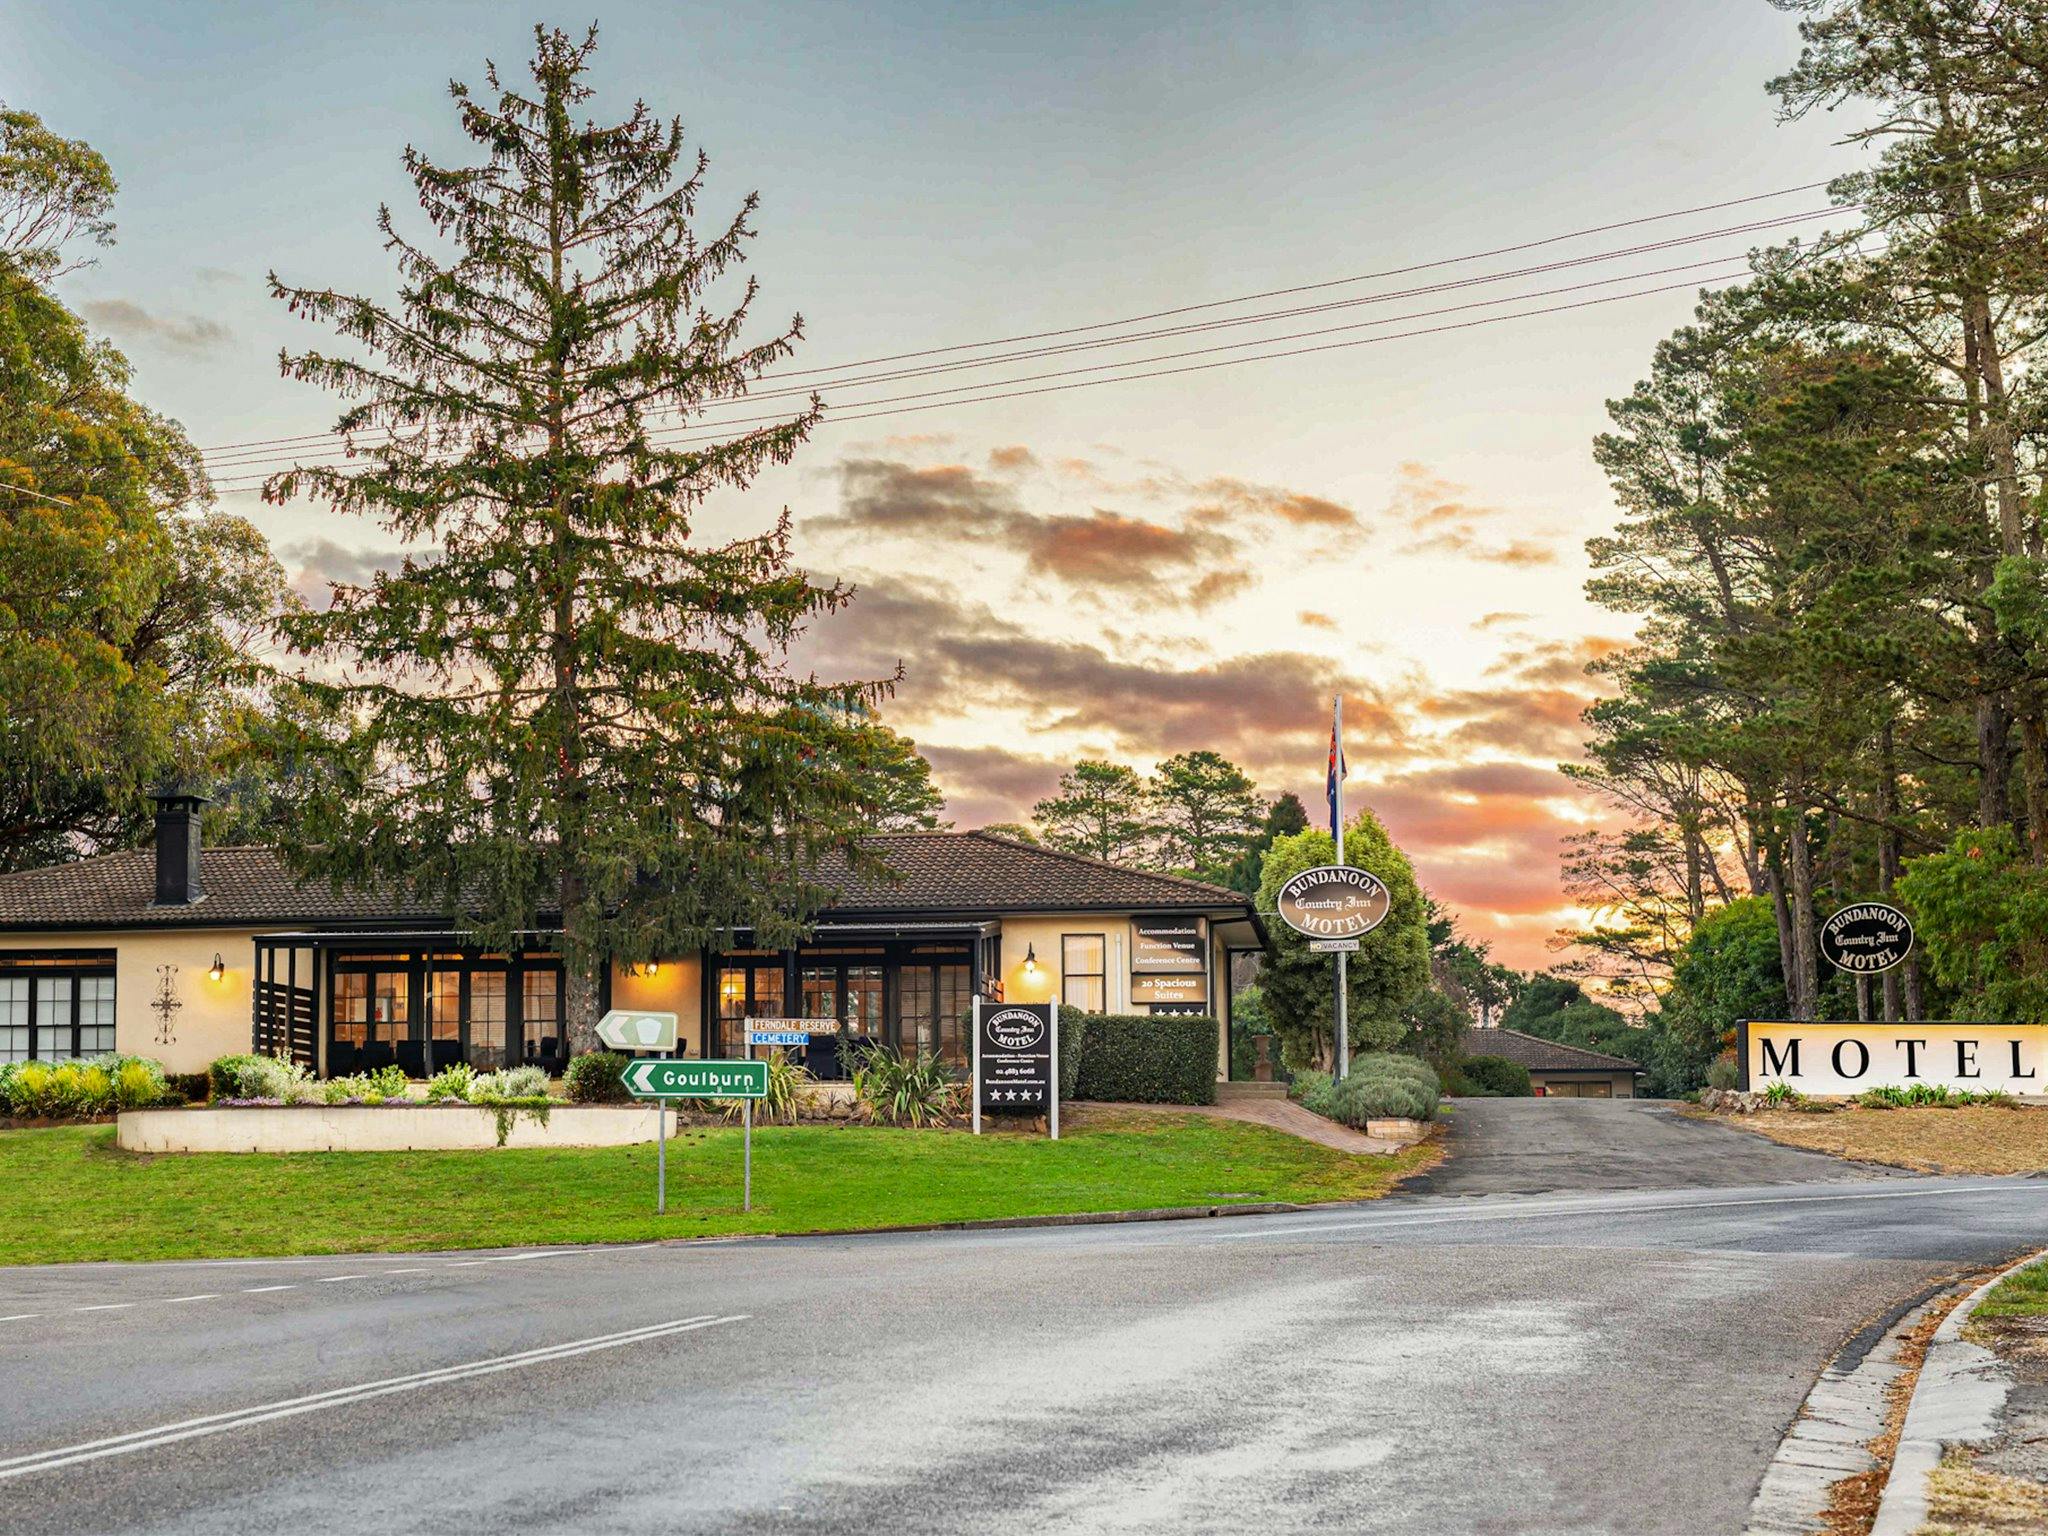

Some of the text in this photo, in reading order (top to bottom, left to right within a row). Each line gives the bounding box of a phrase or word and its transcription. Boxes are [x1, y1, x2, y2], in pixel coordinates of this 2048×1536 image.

[1288, 870, 1381, 898] BUNDANOON
[1295, 895, 1371, 912] Country Inn
[1300, 912, 1371, 934] MOTEL
[1828, 907, 1906, 935] BUNDANOON
[1139, 927, 1197, 935] Accommodation
[1835, 931, 1899, 947] Country Inn
[1135, 956, 1201, 964] Conference Centre
[1839, 947, 1898, 969] MOTEL
[1154, 979, 1197, 989] Spacious
[1154, 990, 1184, 999] Suites
[755, 1020, 836, 1032] FERNDALE RESERVE
[992, 1012, 1040, 1027] BUNDANOON
[995, 1026, 1020, 1034] Country
[755, 1033, 806, 1044] CEMETERY
[998, 1034, 1034, 1046] MOTEL
[1758, 1037, 2036, 1079] MOTEL
[663, 1071, 754, 1087] Goulburn
